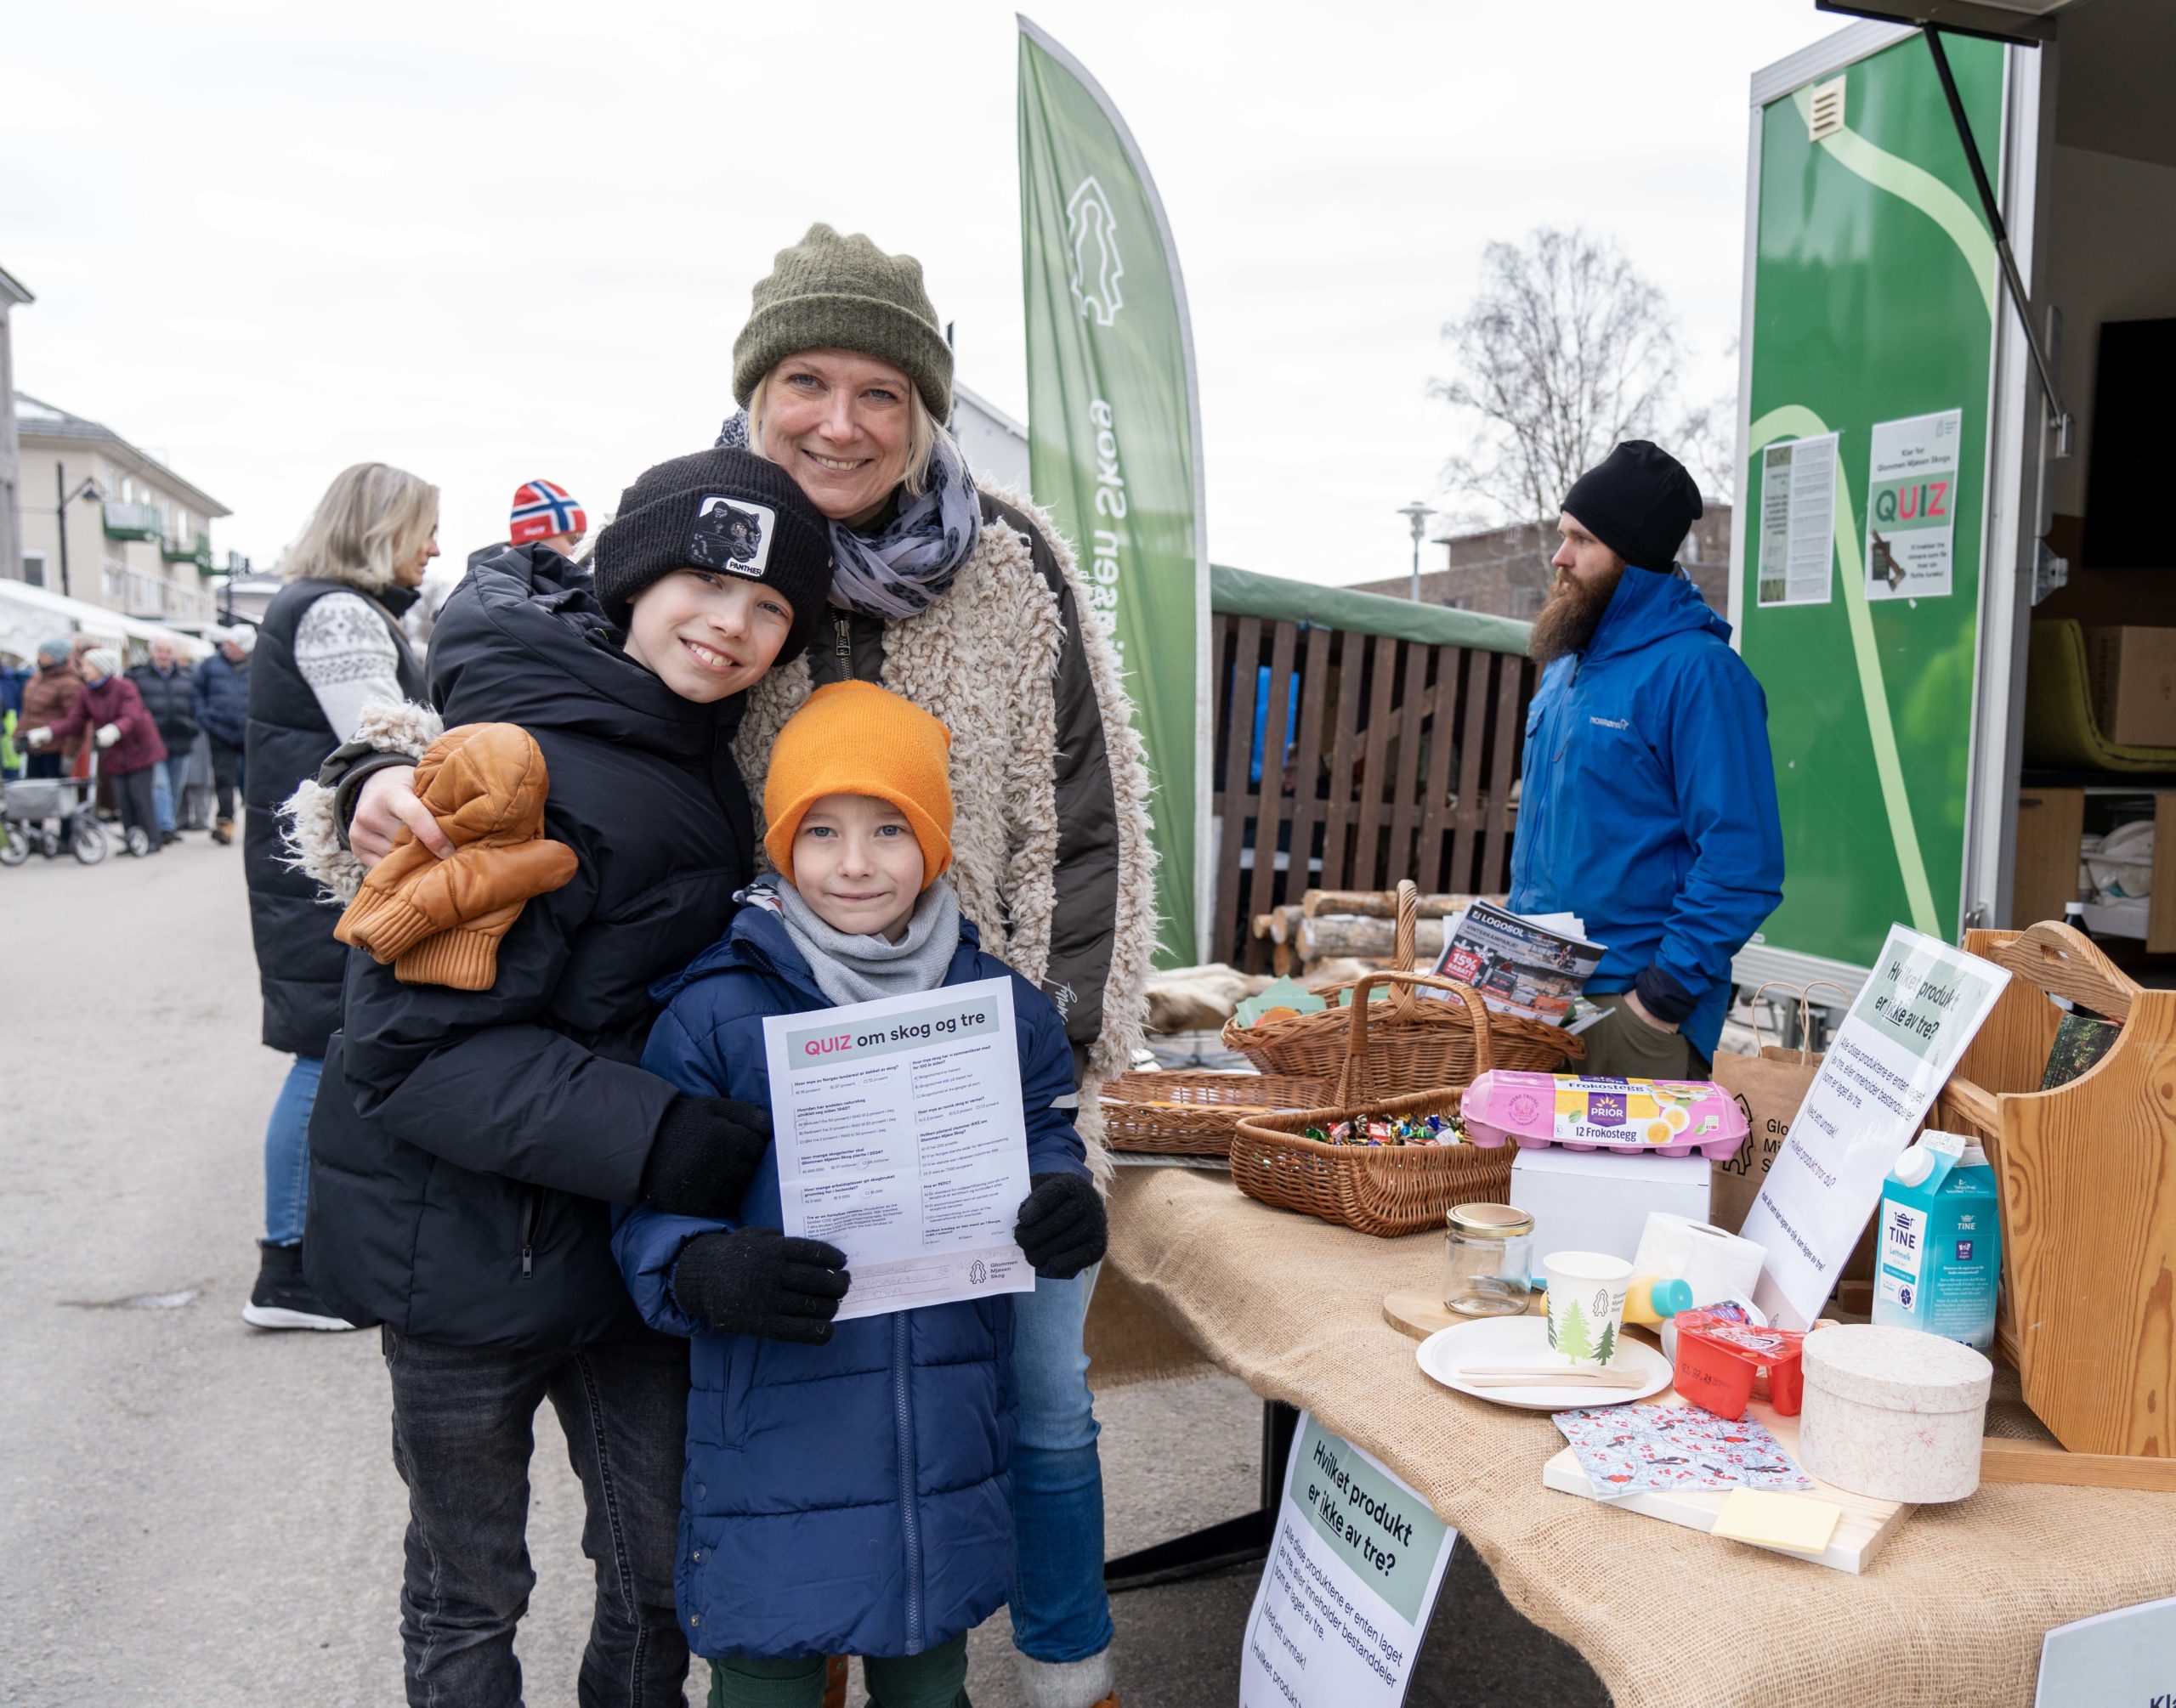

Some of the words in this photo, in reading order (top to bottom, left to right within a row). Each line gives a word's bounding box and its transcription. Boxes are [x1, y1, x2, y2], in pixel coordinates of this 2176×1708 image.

[1875, 481, 1948, 523] QUIZ
[729, 562, 762, 576] PANTHER
[1481, 914, 1523, 937] LOGOSOL
[1448, 963, 1473, 977] RABATT
[1454, 953, 1477, 971] 15%
[1916, 981, 1960, 1011] produkt
[805, 1034, 852, 1055] QUIZ
[857, 1033, 886, 1047] om
[891, 1022, 930, 1041] skog
[936, 1020, 956, 1033] og
[960, 1013, 985, 1026] tre
[1875, 996, 1888, 1011] er
[1884, 996, 1907, 1024] ikke
[1904, 1013, 1919, 1029] av
[1916, 1015, 1940, 1040] tre?
[1831, 1055, 1838, 1066] av
[1844, 1064, 1856, 1077] eller
[1853, 1069, 1880, 1096] inneholder
[1840, 1037, 1850, 1050] Alle
[1848, 1043, 1862, 1059] disse
[1857, 1053, 1888, 1077] produktene
[1886, 1071, 1895, 1081] er
[1892, 1076, 1909, 1094] enten
[1568, 1083, 1644, 1092] Frokostegg
[1822, 1072, 1833, 1083] som
[1831, 1079, 1839, 1088] er
[1837, 1081, 1850, 1098] laget
[1846, 1092, 1855, 1102] av
[1591, 1108, 1624, 1117] PRIOR
[1807, 1103, 1817, 1118] Med
[1814, 1113, 1822, 1125] ett
[1820, 1120, 1839, 1139] unntak!
[1576, 1127, 1584, 1137] 12
[1586, 1128, 1637, 1142] Frokostegg
[1789, 1137, 1803, 1157] Hvilket
[1799, 1151, 1817, 1173] produkt
[1816, 1163, 1826, 1179] tror
[1823, 1173, 1836, 1189] du?
[1890, 1226, 1916, 1249] TINE
[990, 1266, 1012, 1275] Mjøsen
[1816, 1258, 1826, 1272] tre!
[1313, 1440, 1350, 1495] Hvilket
[1349, 1485, 1413, 1547] produkt
[1309, 1484, 1319, 1504] er
[1318, 1490, 1343, 1534] ikke
[1346, 1524, 1362, 1548] av
[1363, 1536, 1396, 1577] tre?
[1275, 1565, 1285, 1586] som
[1285, 1581, 1290, 1592] er
[1290, 1587, 1305, 1615] laget
[1305, 1611, 1313, 1625] av
[1313, 1618, 1324, 1641] tre.
[1284, 1524, 1294, 1544] Alle
[1294, 1538, 1306, 1563] disse
[1306, 1558, 1343, 1607] produktene
[1345, 1603, 1354, 1616] er
[1355, 1613, 1378, 1643] enten
[1379, 1633, 1402, 1667] laget
[1264, 1602, 1276, 1626] Med
[1275, 1623, 1284, 1640] ett
[1283, 1634, 1306, 1671] unntak!
[1280, 1547, 1287, 1558] av
[1285, 1553, 1294, 1574] tre,
[1294, 1567, 1306, 1588] eller
[1306, 1581, 1341, 1631] inneholder
[1341, 1623, 1397, 1688] bestanddeler
[1253, 1640, 1272, 1677] Hvilket
[1272, 1671, 1297, 1708] produkt
